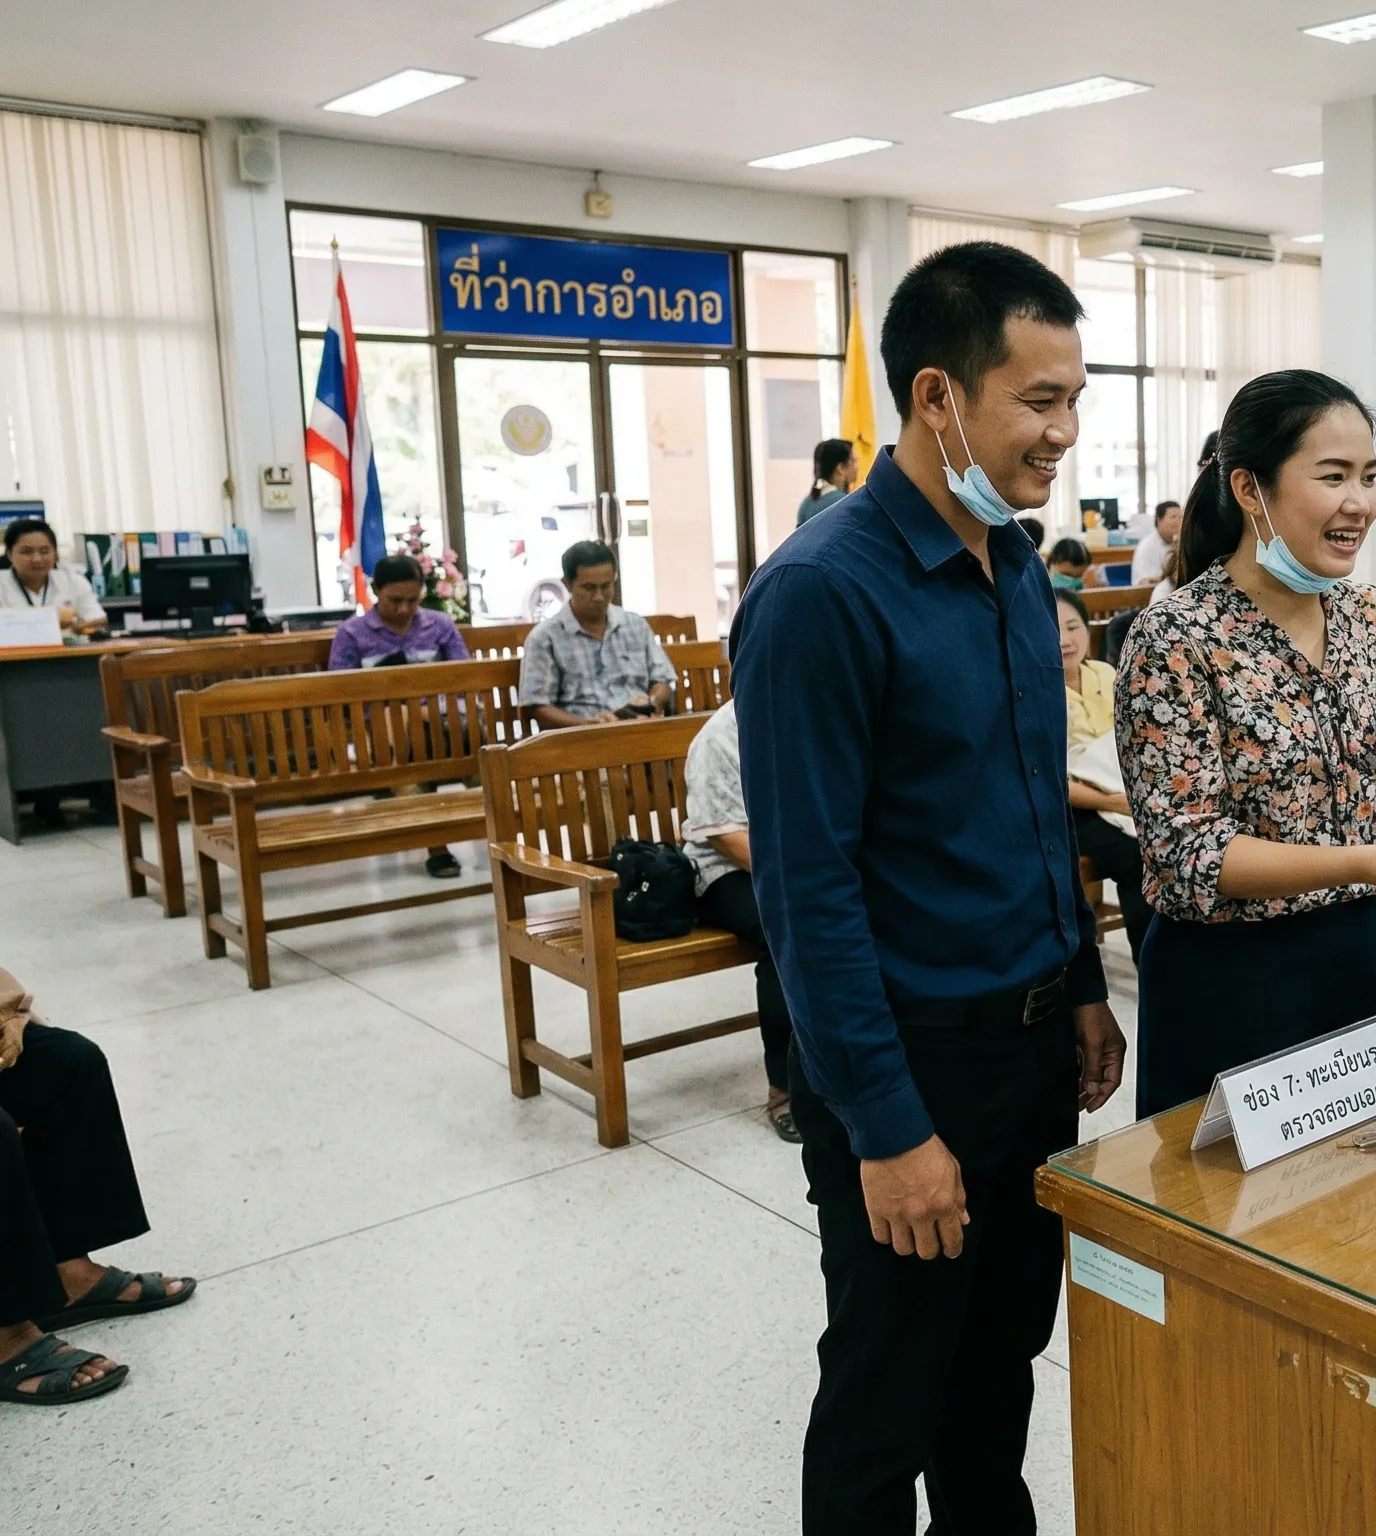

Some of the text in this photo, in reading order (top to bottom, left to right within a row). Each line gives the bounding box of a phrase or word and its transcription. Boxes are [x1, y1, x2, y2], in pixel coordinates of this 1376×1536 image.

[449, 243, 724, 325] ที่ว่าการอำเภอ
[1243, 1083, 1281, 1112] ช่อง
[1283, 1074, 1303, 1097] 7:
